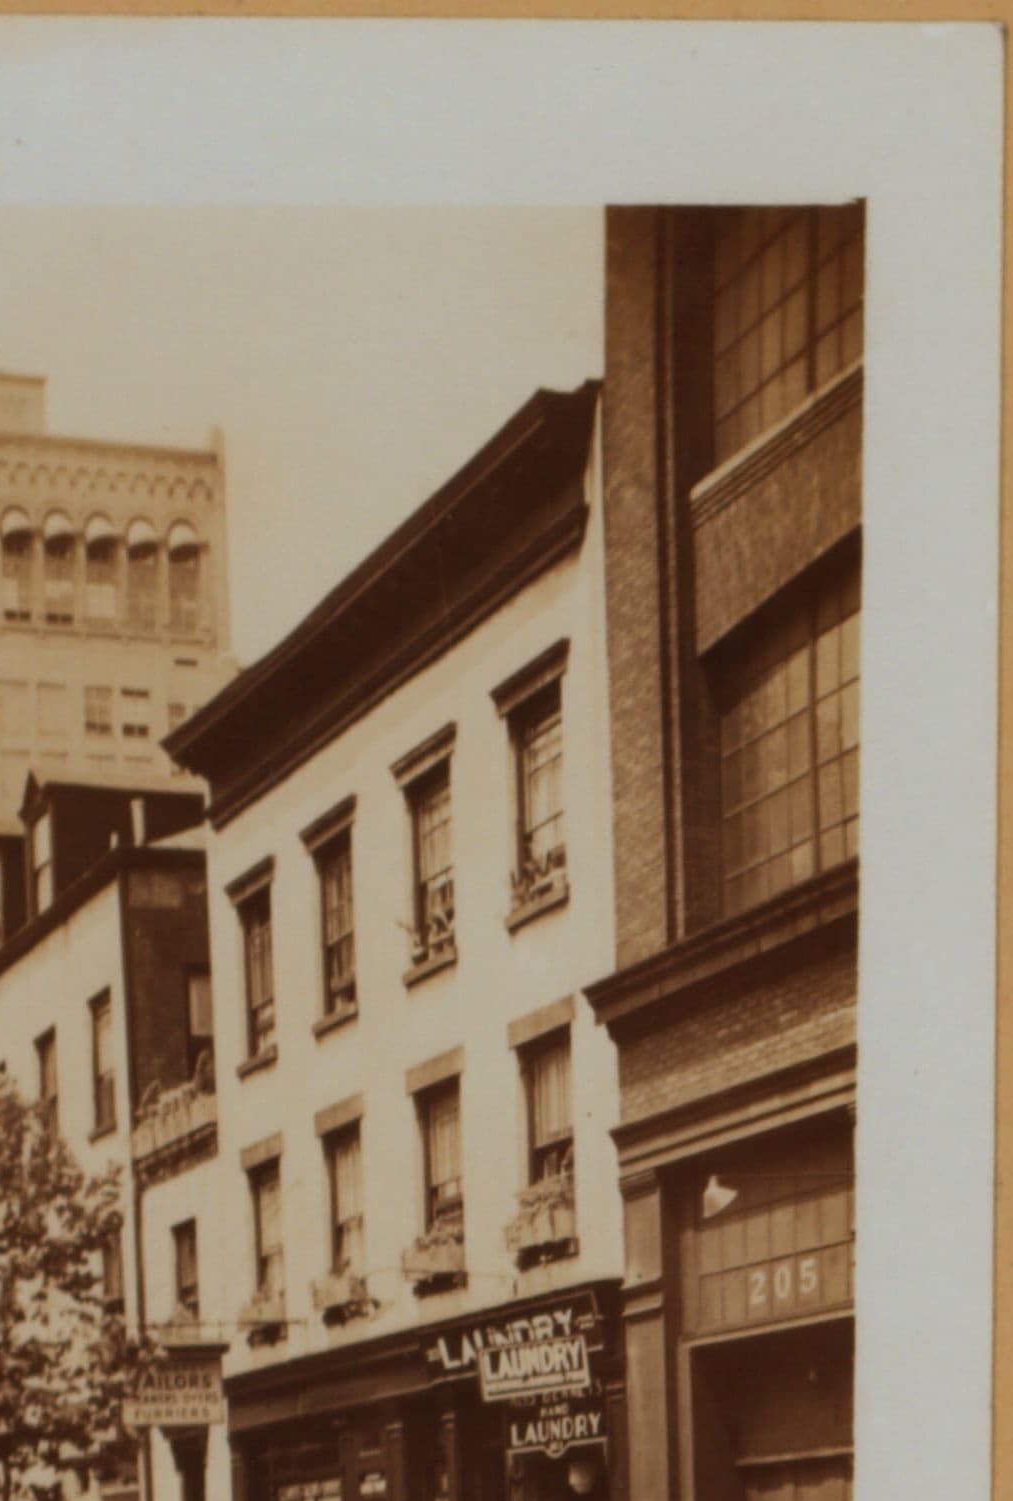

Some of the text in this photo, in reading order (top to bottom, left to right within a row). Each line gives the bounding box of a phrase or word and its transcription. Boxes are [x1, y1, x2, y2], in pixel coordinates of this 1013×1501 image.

[749, 1258, 817, 1305] 205
[483, 1340, 582, 1380] LAUNDRY
[134, 1371, 213, 1389] AILORS
[510, 1412, 602, 1447] LAUNDRY
